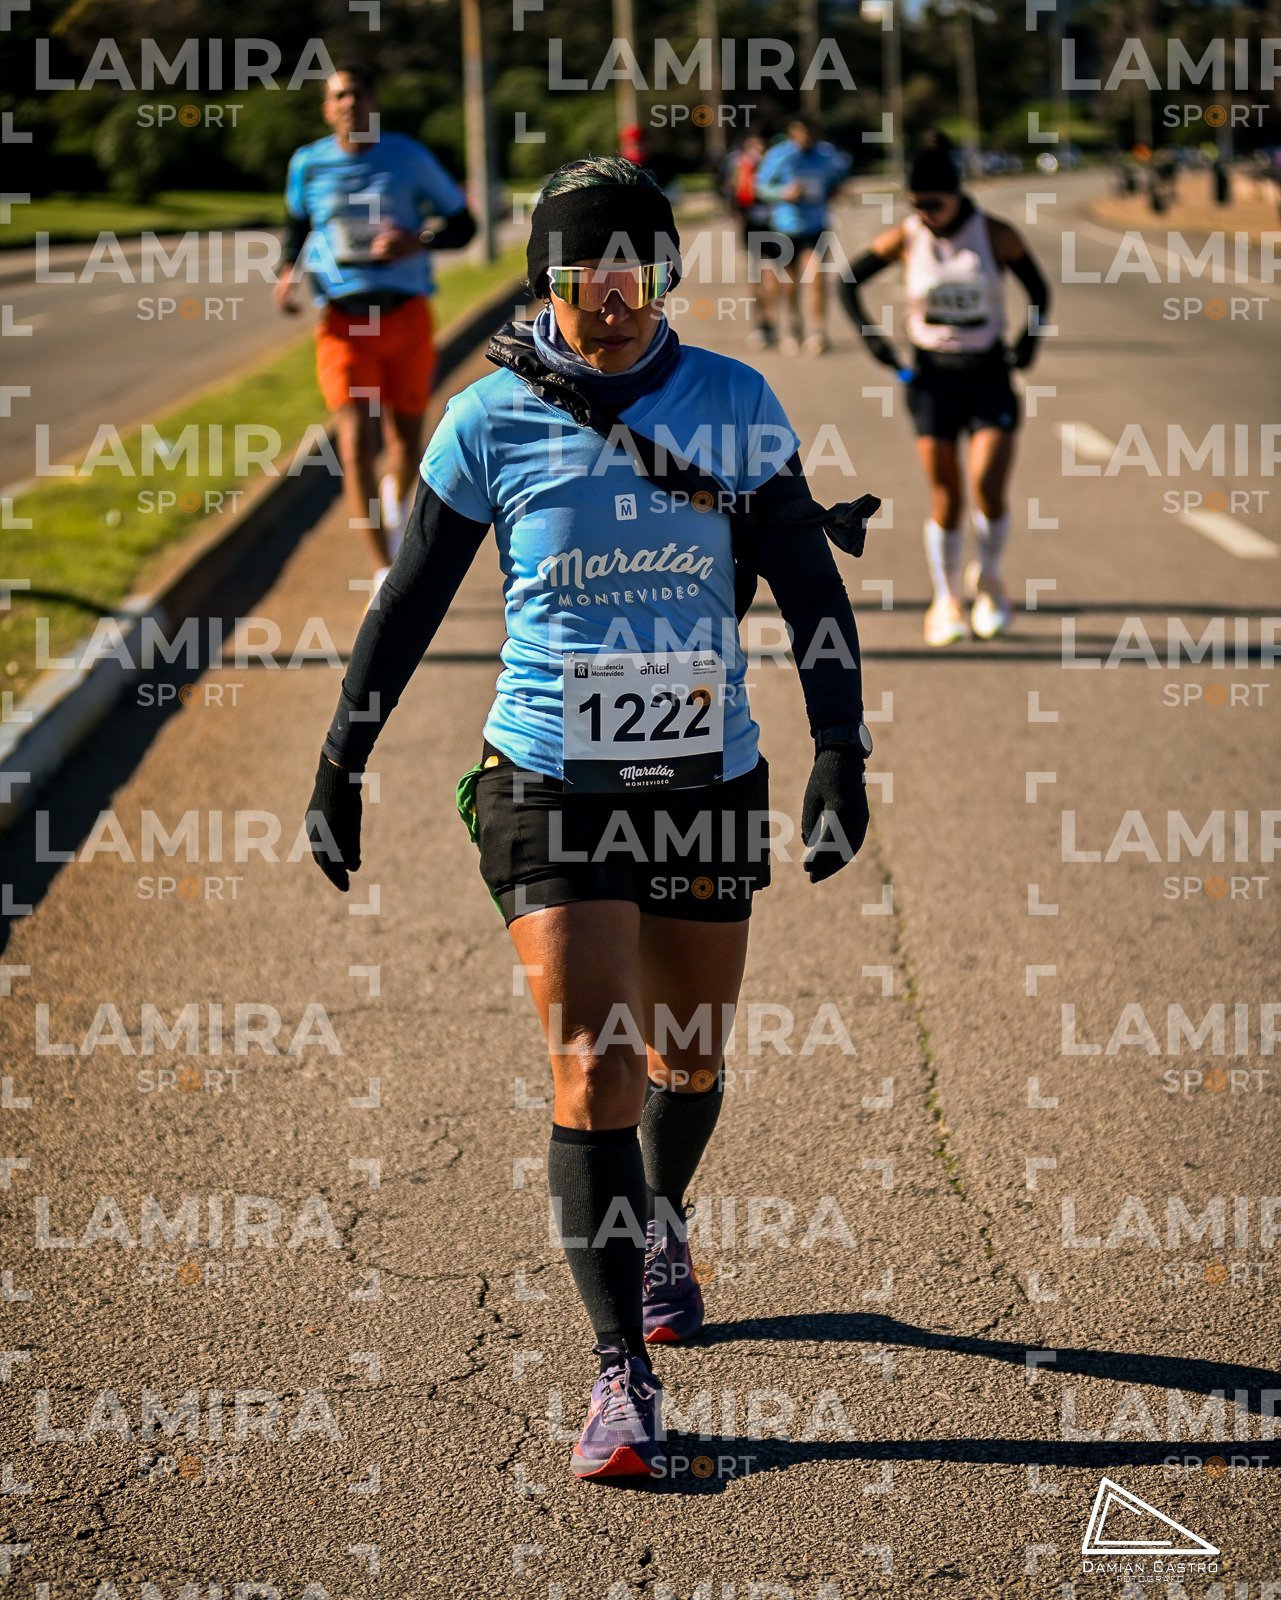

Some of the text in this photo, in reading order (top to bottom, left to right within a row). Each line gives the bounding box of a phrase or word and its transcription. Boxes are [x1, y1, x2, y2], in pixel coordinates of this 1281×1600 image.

[537, 542, 714, 590] Maratón
[558, 583, 700, 607] MONTEVIDEO
[640, 662, 670, 676] antel
[579, 689, 712, 742] 1222
[620, 764, 675, 780] Maratón
[625, 779, 670, 787] MONTEVIDEO
